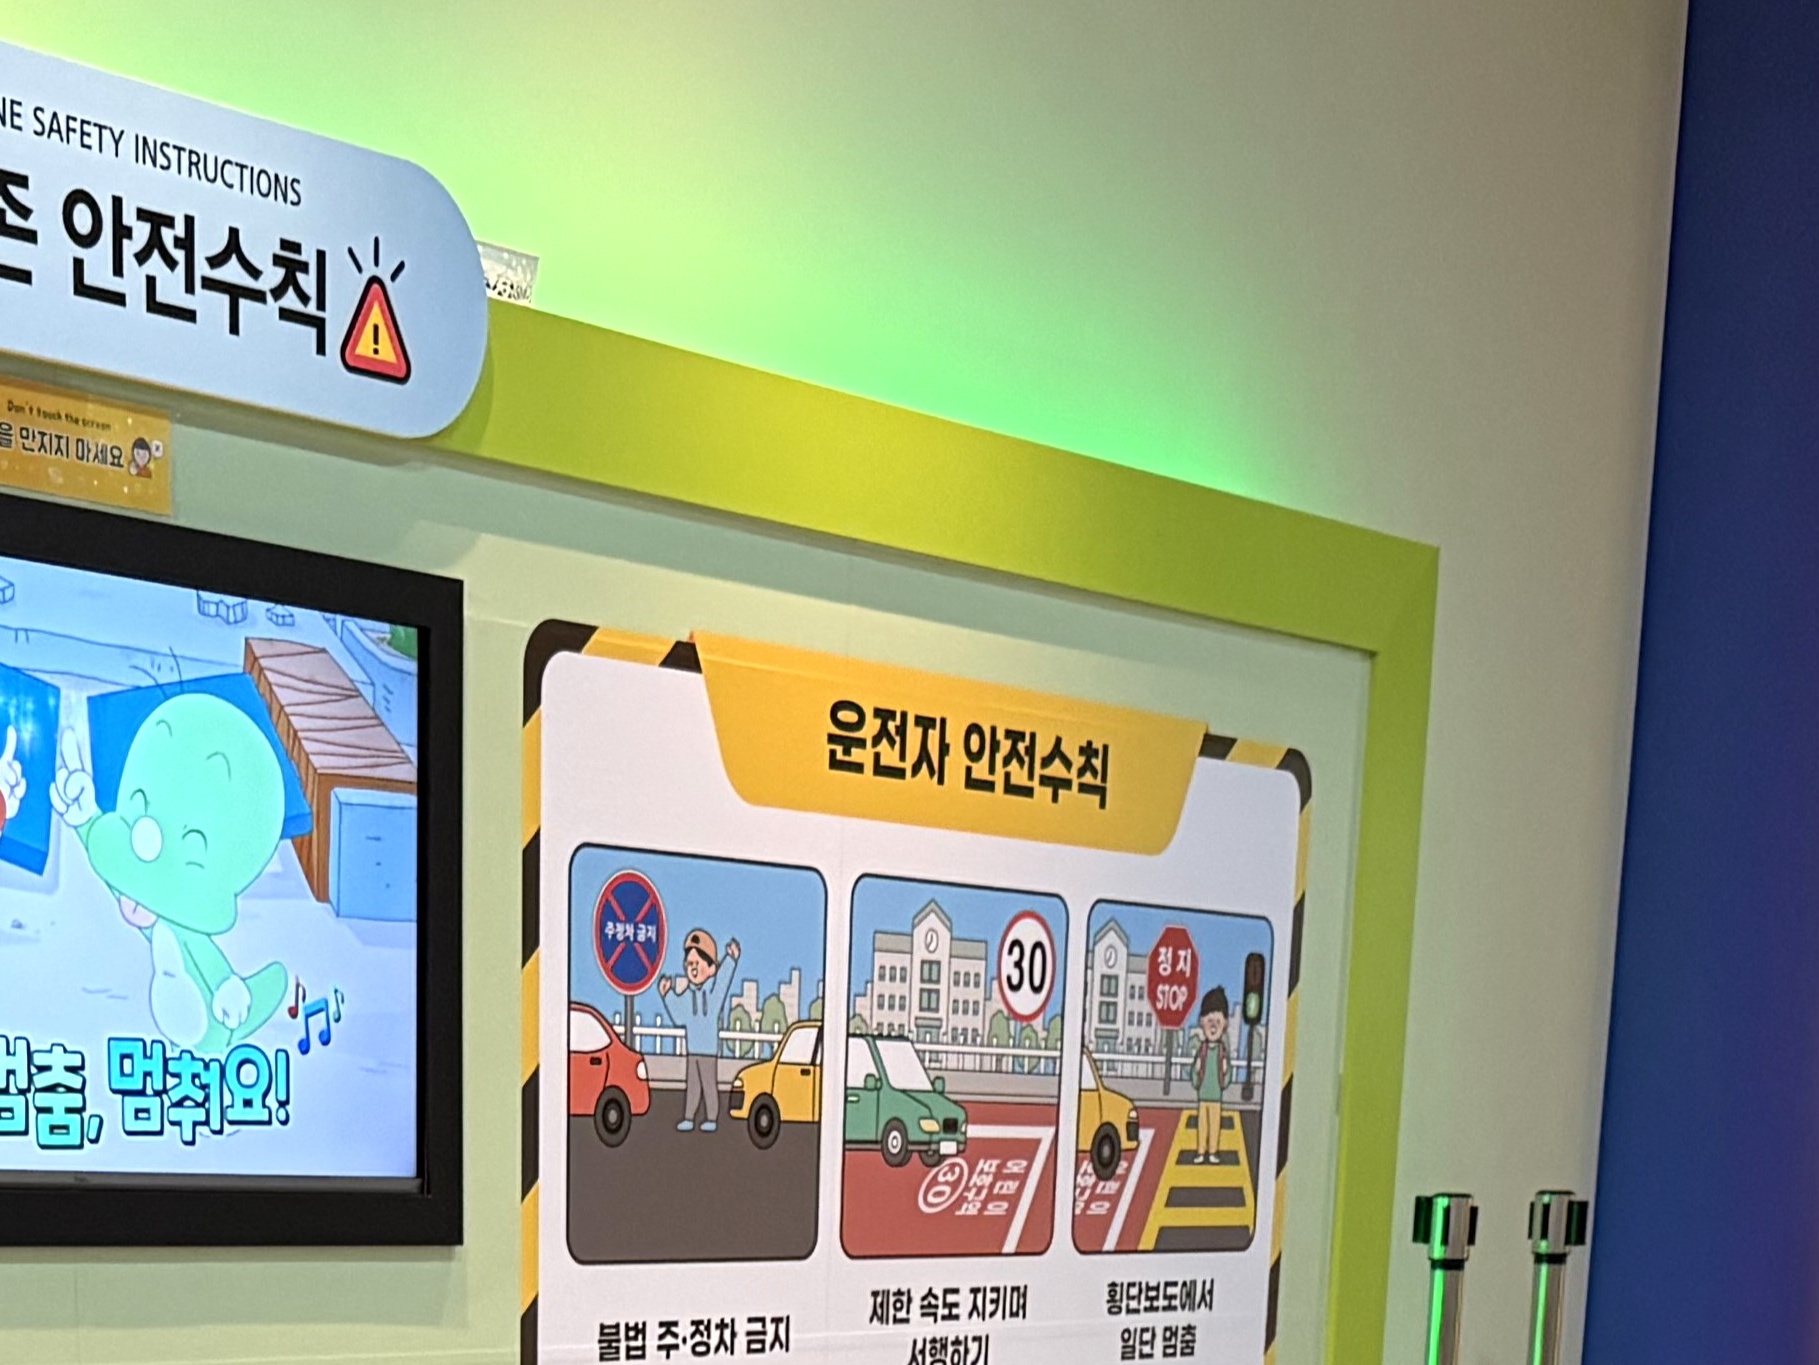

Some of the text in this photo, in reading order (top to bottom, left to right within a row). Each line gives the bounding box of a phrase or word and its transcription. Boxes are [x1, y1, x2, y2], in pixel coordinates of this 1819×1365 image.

[33, 106, 125, 158] SAFETY
[134, 133, 303, 207] INSTRUCTIONS
[61, 187, 328, 358] 안전수칙
[7, 399, 34, 417] Don't
[36, 406, 63, 422] touch
[65, 412, 80, 426] the
[19, 426, 70, 460] 만지지
[75, 438, 125, 469] 마세요
[827, 699, 1110, 811] 운전자 안전수칙
[636, 922, 657, 943] 금지
[1006, 938, 1048, 996] 30
[1156, 983, 1188, 1012] STOP
[106, 1036, 293, 1146] 멈춰요!
[869, 1284, 1028, 1326] 제한 속도 지키며
[1106, 1278, 1215, 1317] 횡단보도에서
[597, 1314, 790, 1363] 불법 주·정차 금지
[1119, 1322, 1198, 1362] 일단 멈춤
